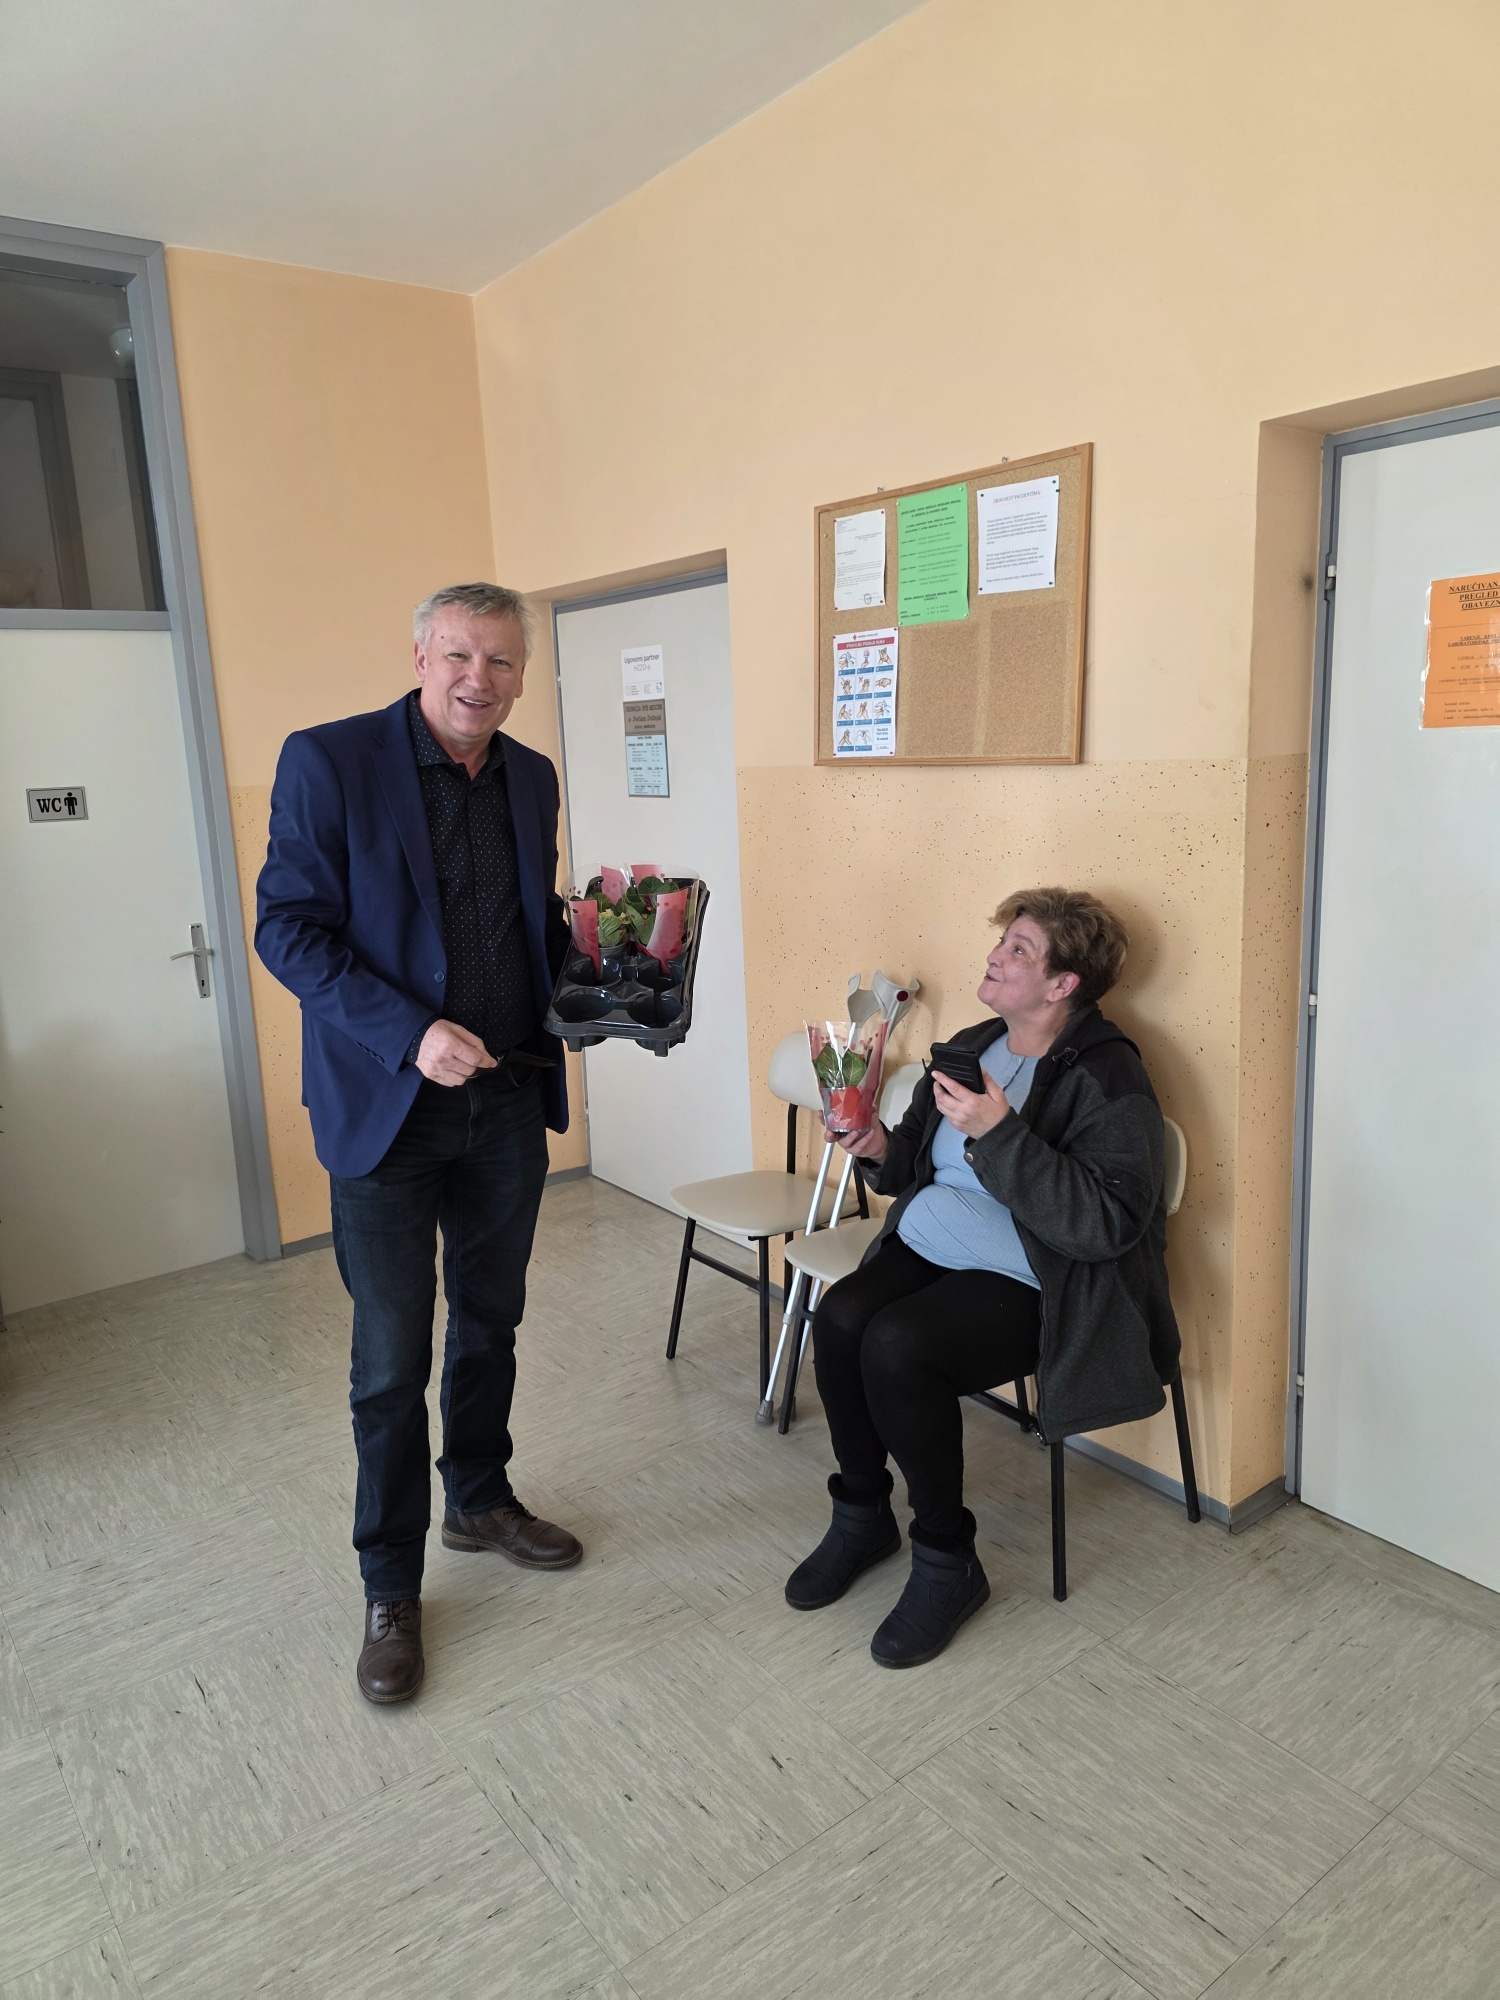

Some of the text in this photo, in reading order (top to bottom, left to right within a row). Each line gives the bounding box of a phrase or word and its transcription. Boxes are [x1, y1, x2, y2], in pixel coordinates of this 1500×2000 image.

[1449, 582, 1500, 592] NARUČIVAN
[1459, 590, 1499, 601] PREGLED
[644, 654, 660, 662] partner
[36, 797, 62, 813] WC
